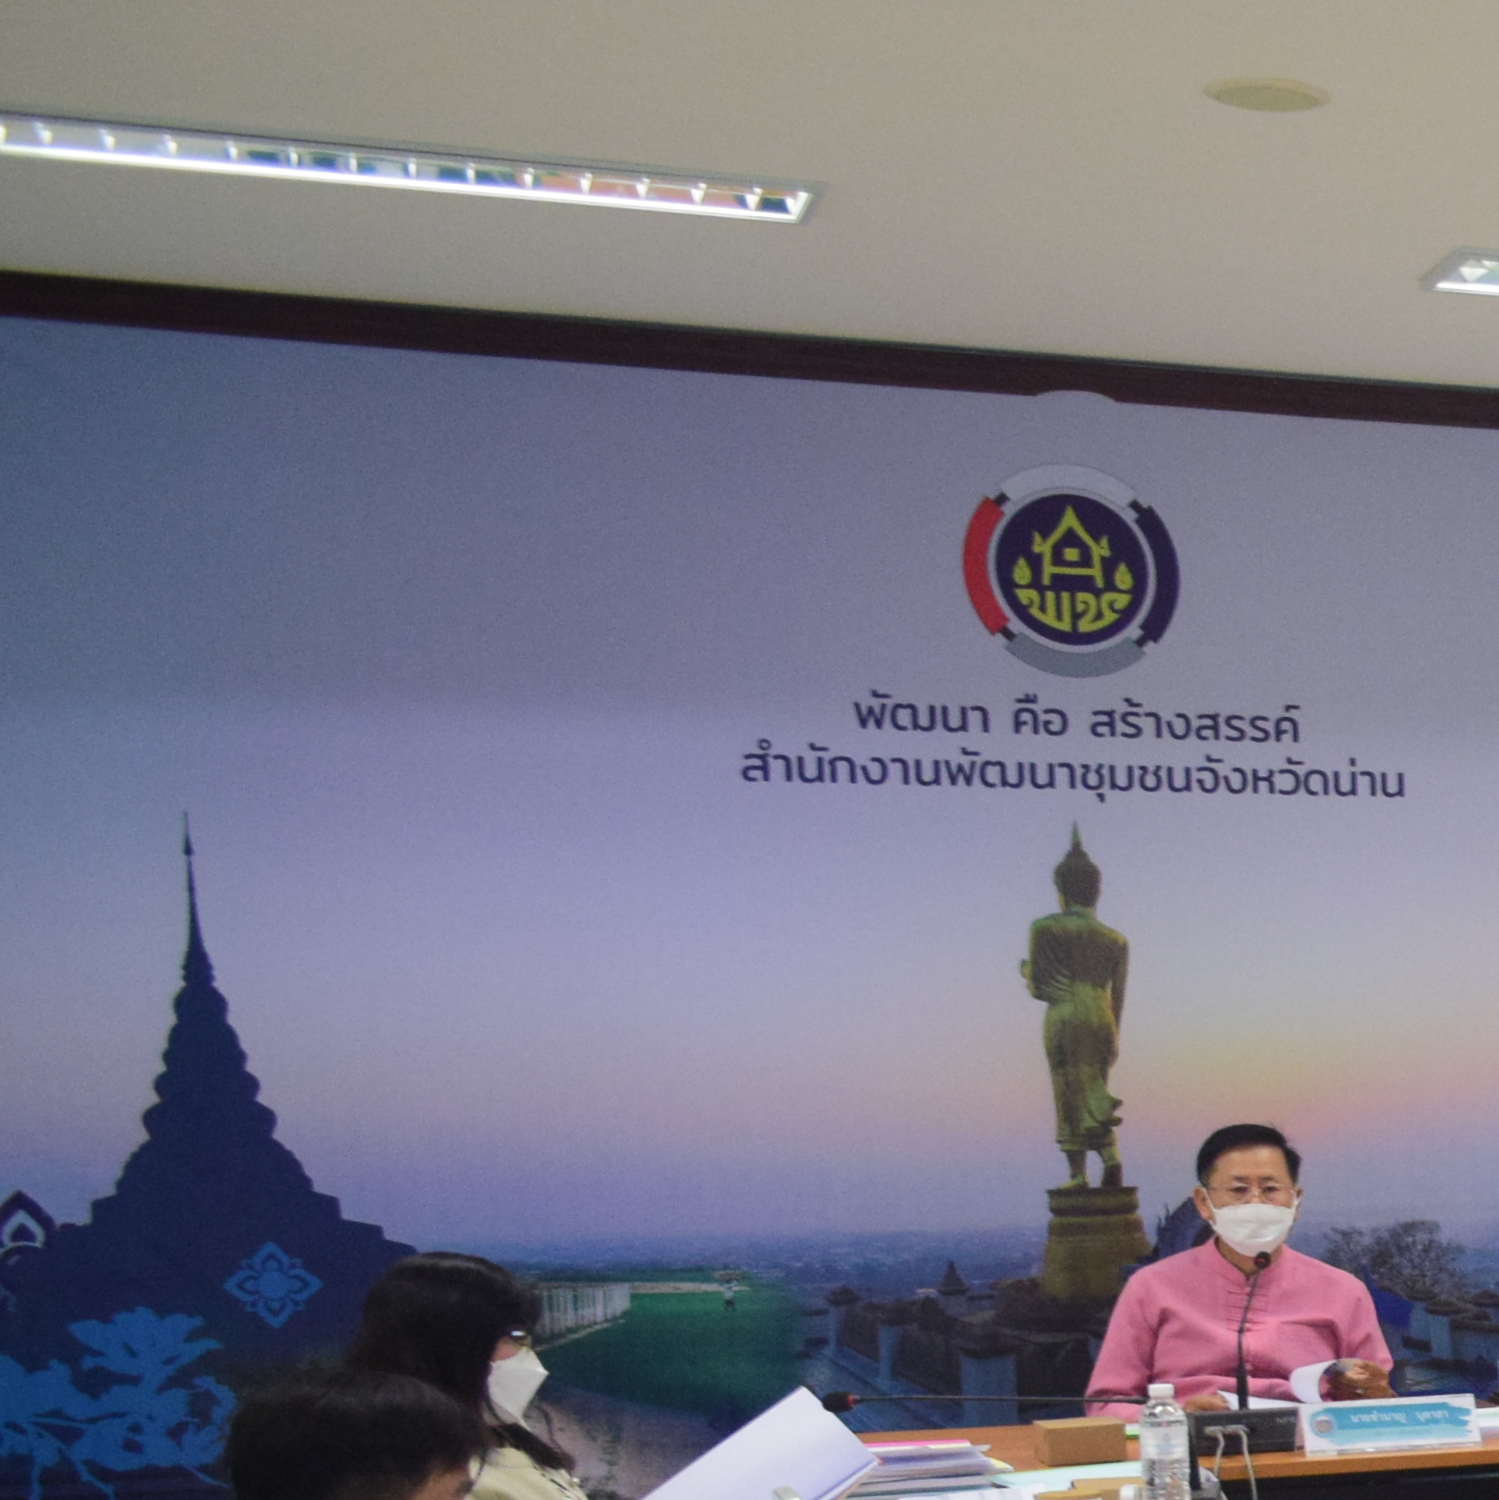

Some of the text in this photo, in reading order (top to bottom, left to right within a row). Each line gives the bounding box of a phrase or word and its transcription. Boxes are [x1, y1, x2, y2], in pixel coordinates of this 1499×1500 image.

[853, 689, 1301, 743] พัฒนา คือ สร้างสรรค์
[741, 738, 1405, 803] สำนักงานพัฒนาชุมชนจังหวัดน่าน
